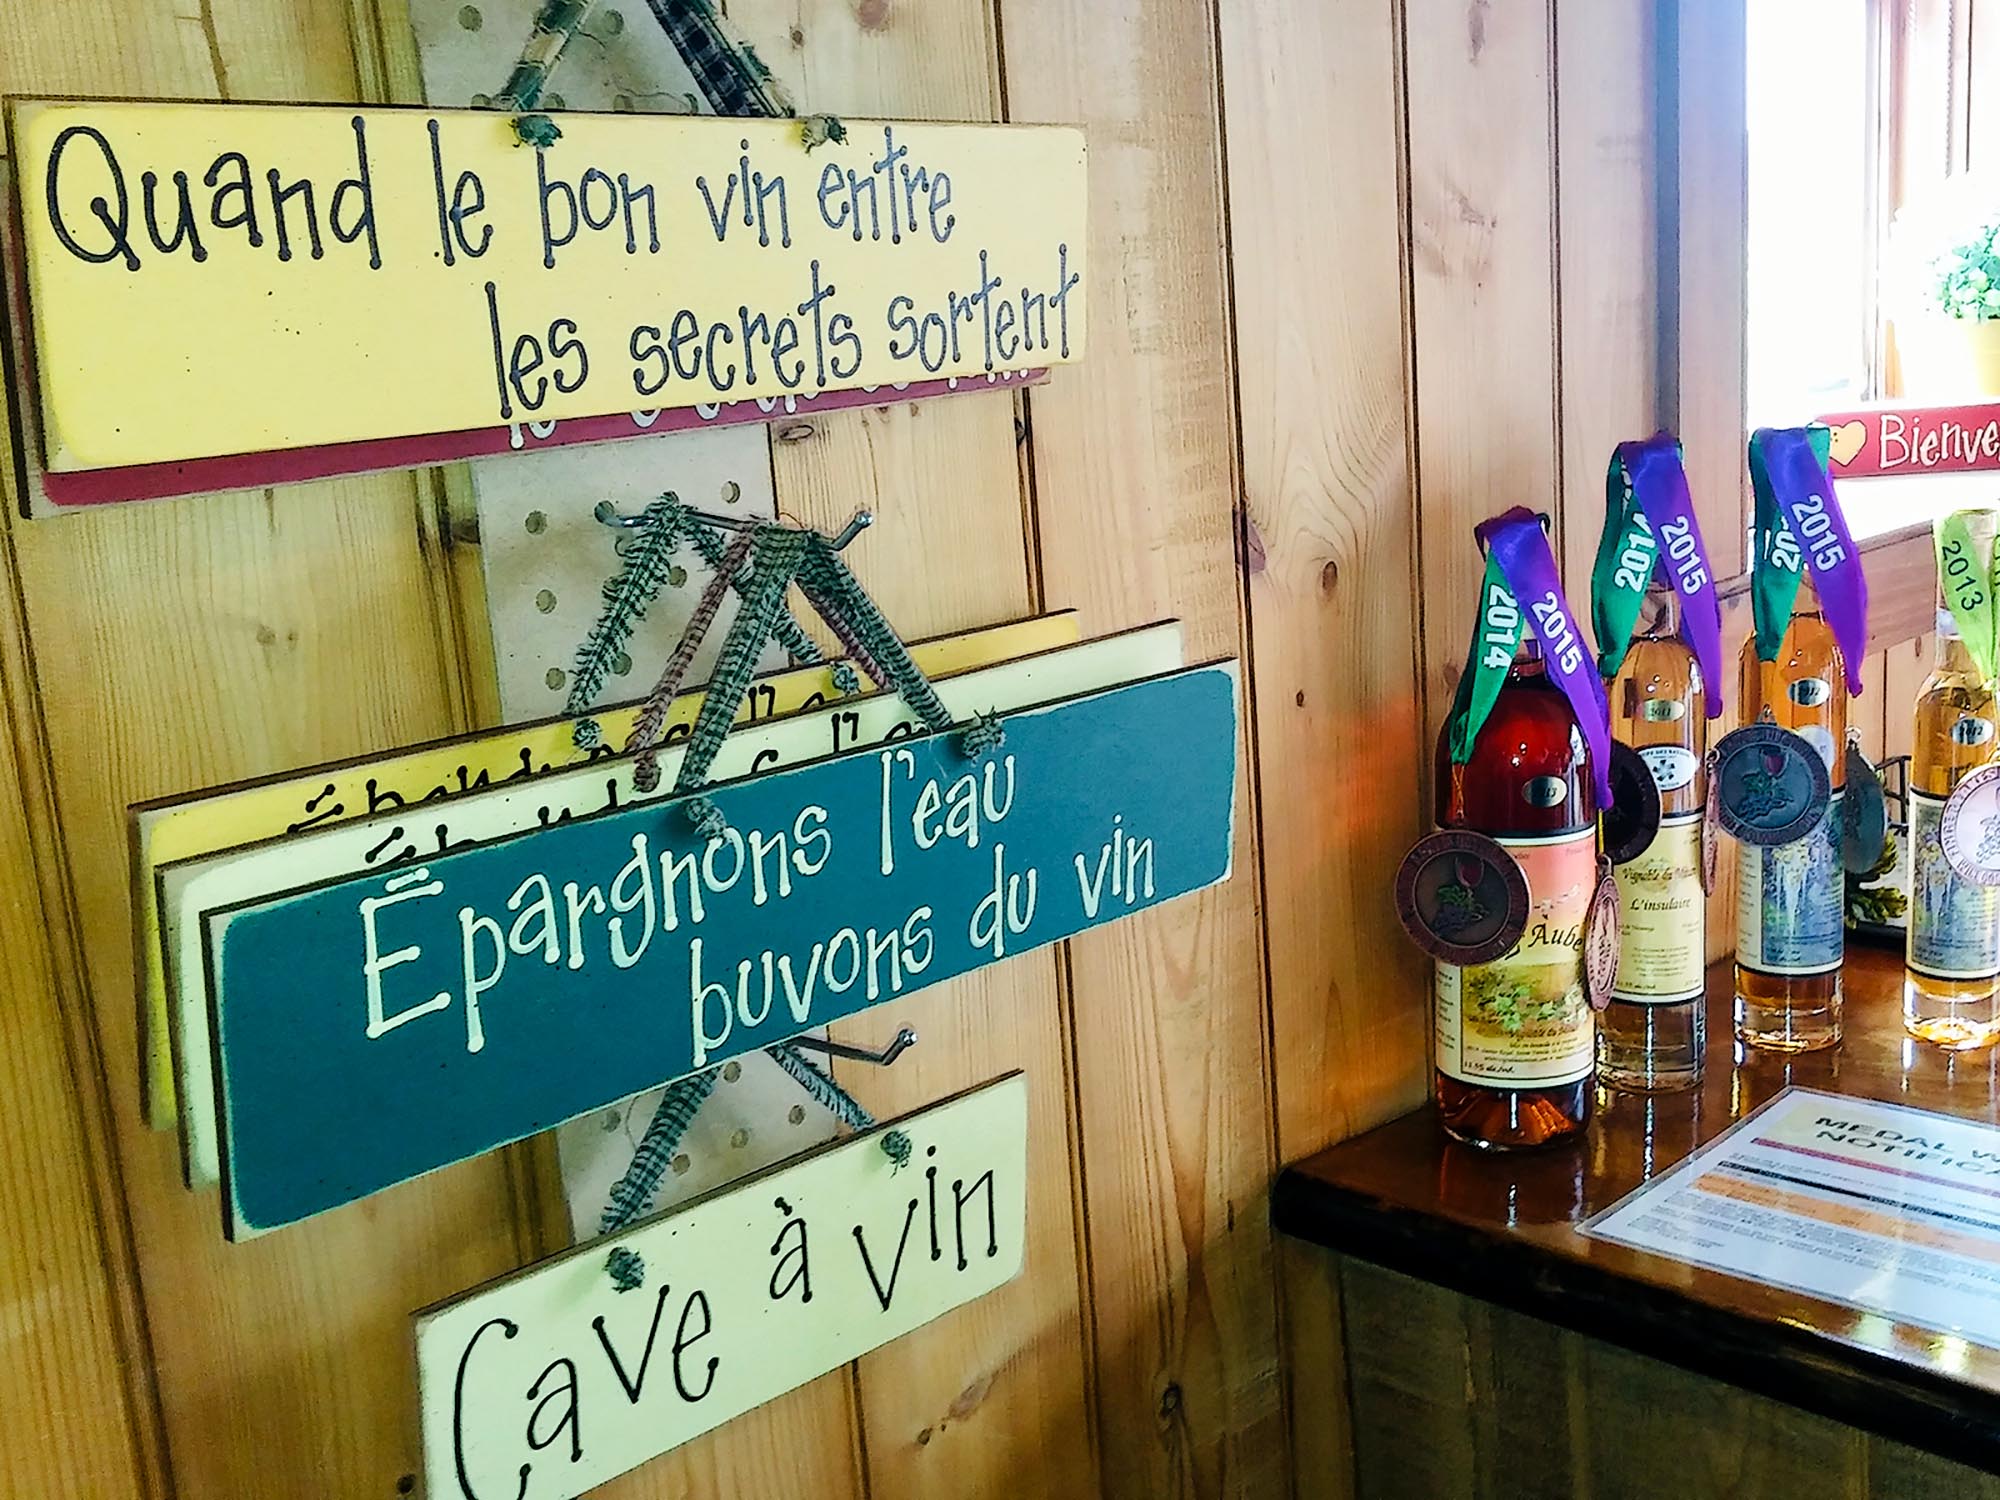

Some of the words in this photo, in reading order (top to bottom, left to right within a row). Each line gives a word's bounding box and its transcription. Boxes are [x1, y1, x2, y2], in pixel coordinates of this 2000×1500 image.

[46, 115, 383, 271] Quand
[427, 119, 494, 267] le
[537, 144, 660, 269] bon
[696, 139, 792, 248] vin
[818, 126, 956, 244] entre
[485, 282, 588, 418] les
[630, 259, 862, 395] secrets
[888, 244, 1079, 372] sortent
[1879, 413, 2000, 469] Bienve
[1660, 516, 1708, 595] 2015
[1792, 494, 1847, 572] 2015
[1941, 540, 1984, 611] 2013
[1483, 584, 1519, 669] 2014
[1531, 591, 1583, 675] 2015
[359, 804, 832, 1053] Épargnons
[881, 749, 1016, 875] l'eau
[690, 905, 934, 1067] buvons
[970, 842, 1038, 958] du
[1074, 814, 1155, 919] vin
[1815, 1117, 1955, 1154] MEDAL
[452, 1284, 721, 1500] Cave
[768, 1196, 813, 1304] à
[852, 1145, 999, 1313] vin
